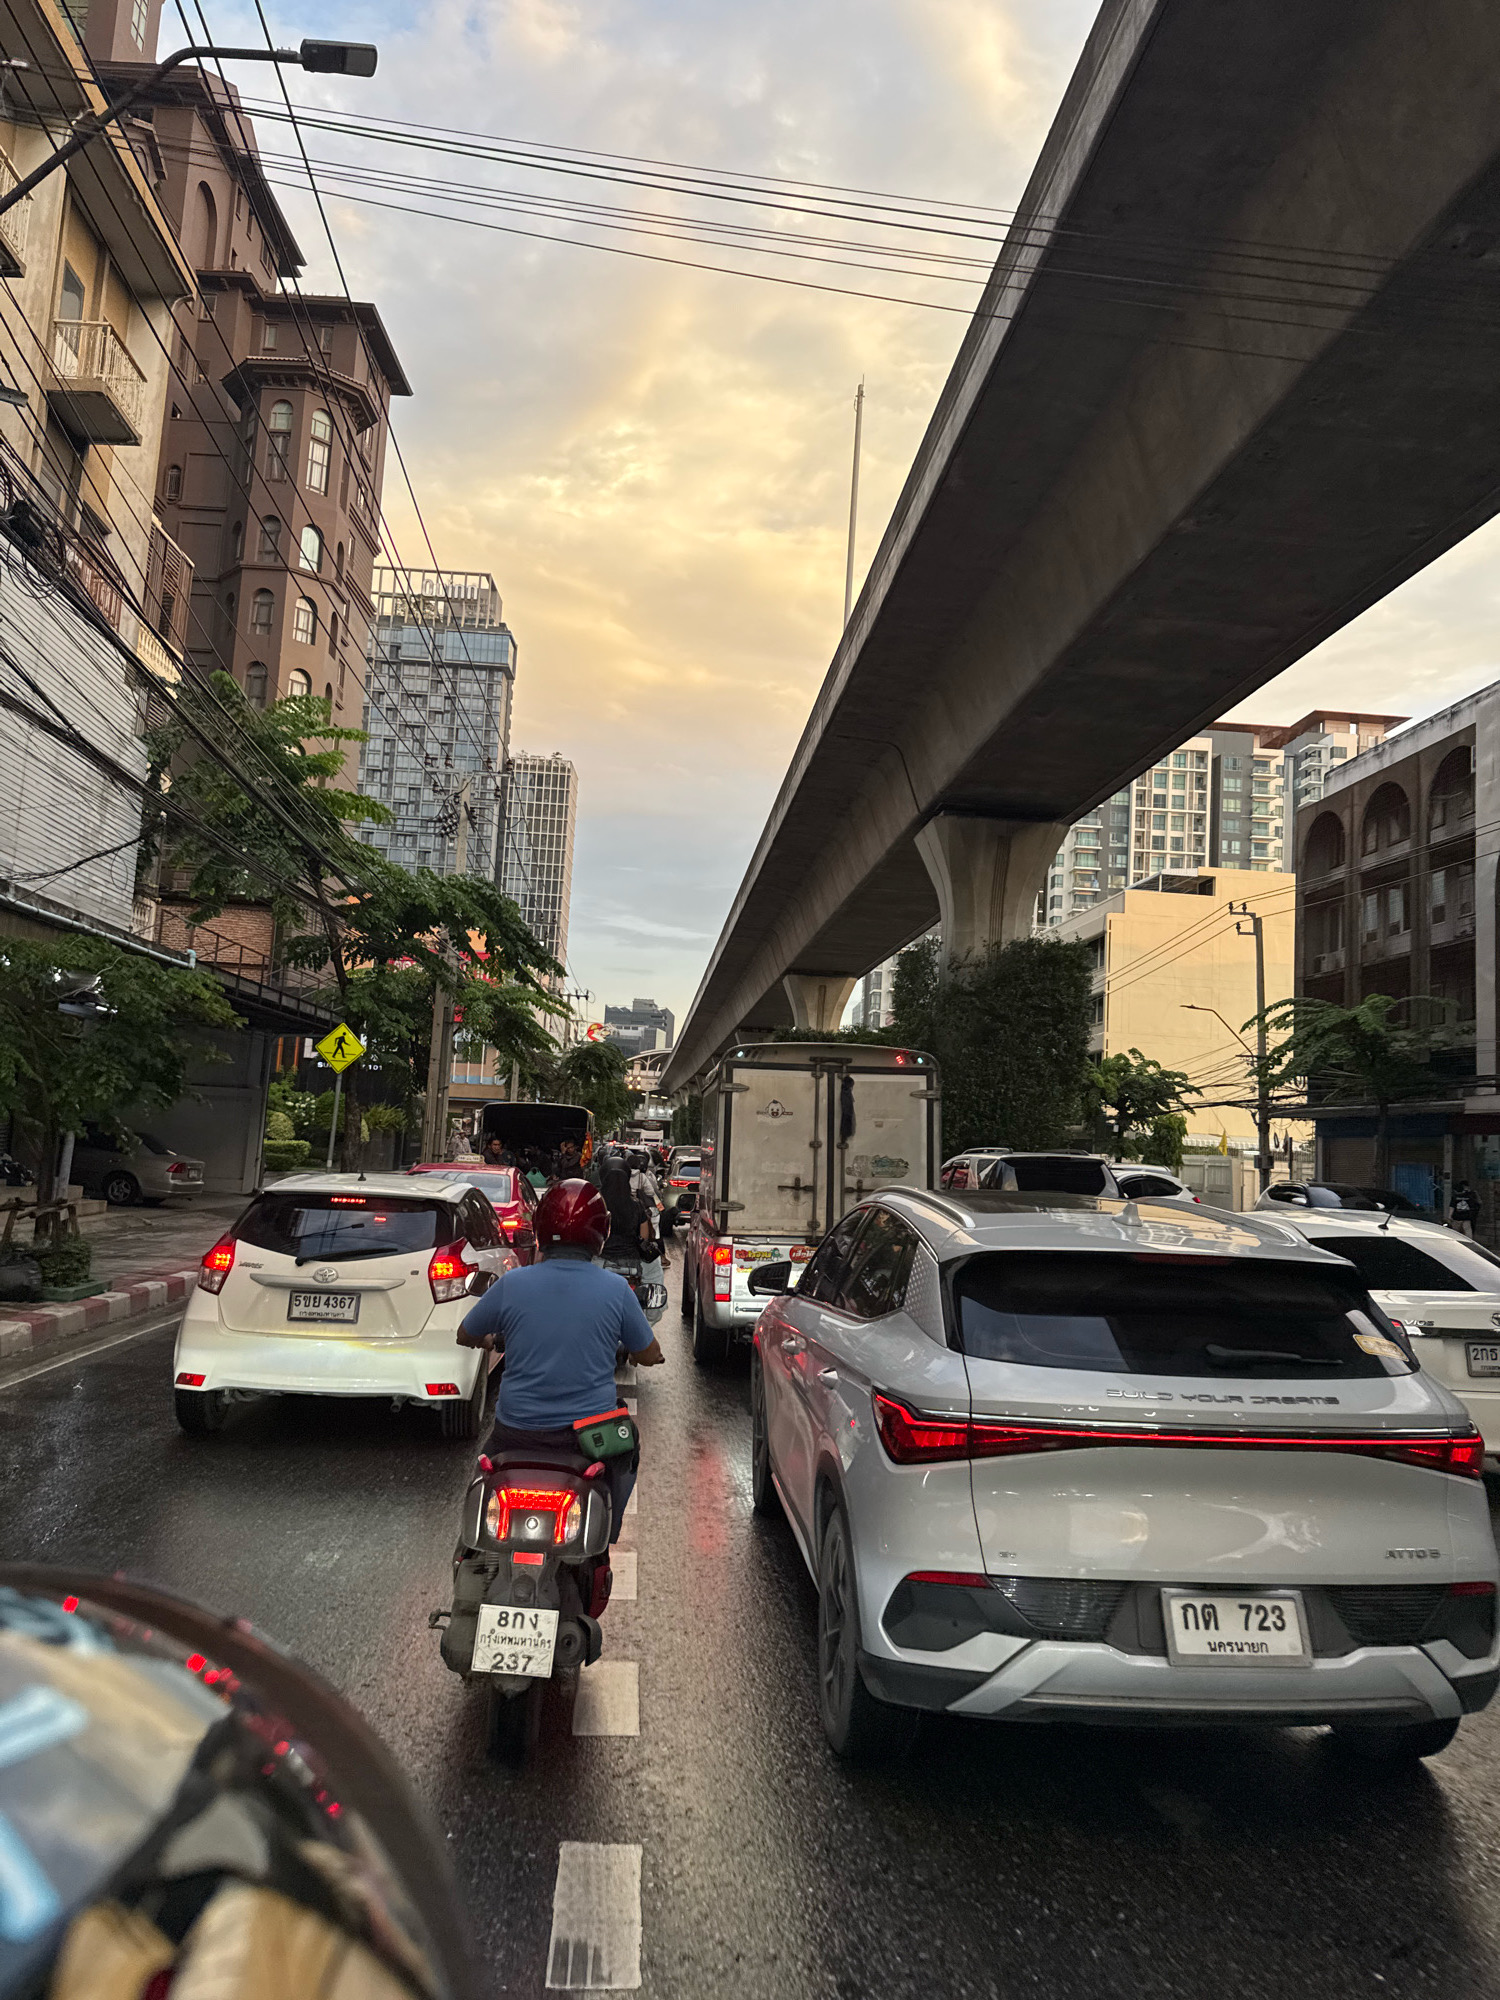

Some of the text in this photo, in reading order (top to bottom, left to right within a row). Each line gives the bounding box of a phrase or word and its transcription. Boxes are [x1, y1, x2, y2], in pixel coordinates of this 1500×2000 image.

[323, 1296, 355, 1309] 4367
[1404, 1319, 1435, 1327] VIOS
[1106, 1388, 1340, 1405] BUILD YOUR DREAMS
[1181, 1603, 1287, 1631] กต 723
[480, 1632, 552, 1649] กรุงเทพมหานคร
[1207, 1641, 1269, 1653] นครนายก
[490, 1652, 535, 1672] 237
